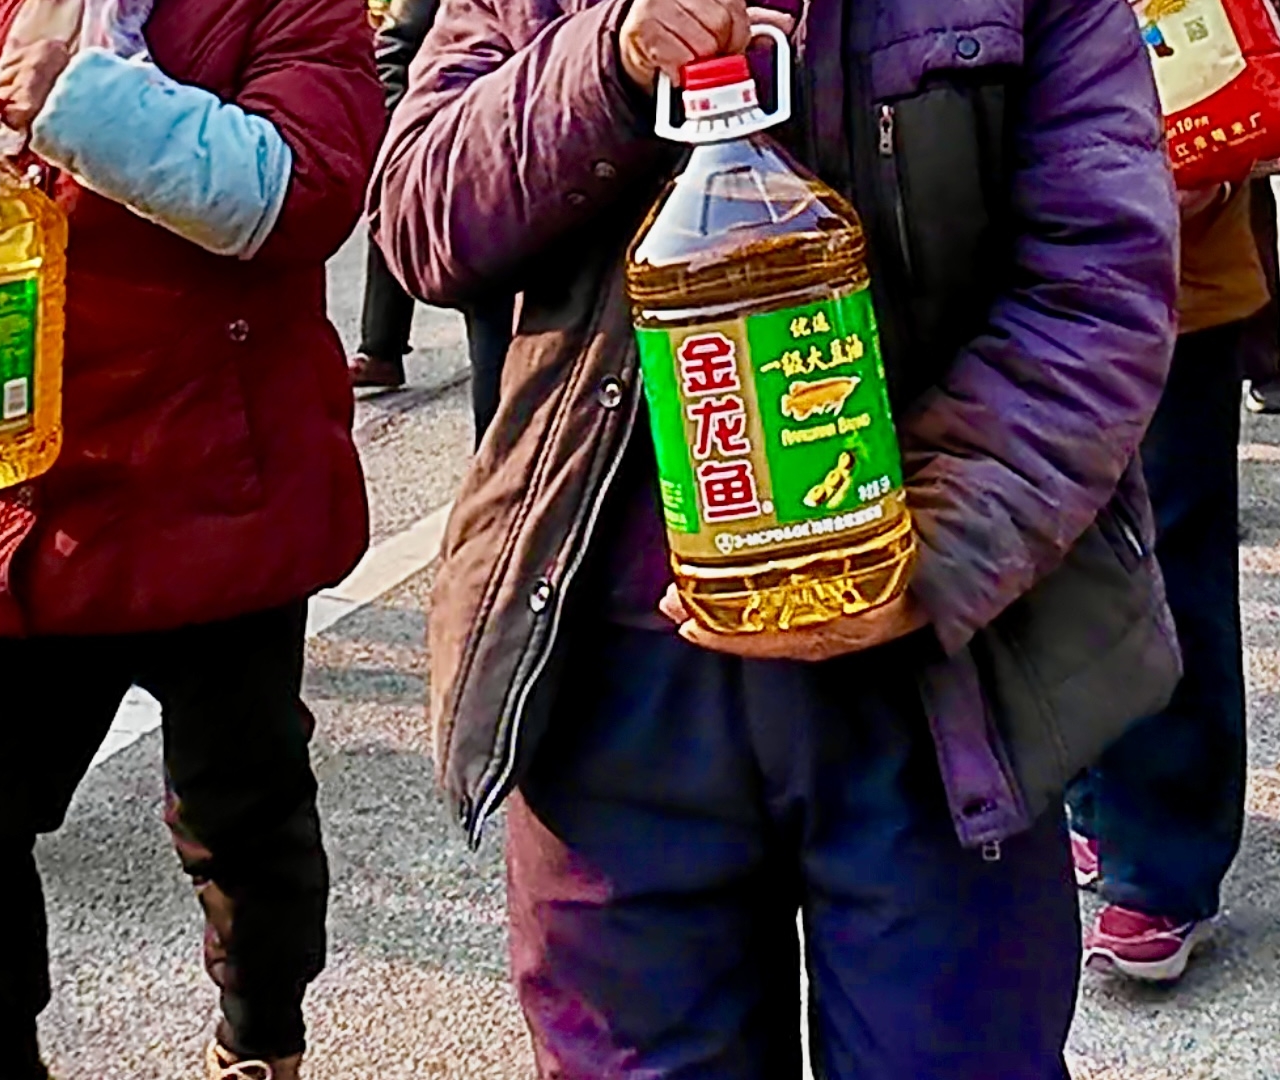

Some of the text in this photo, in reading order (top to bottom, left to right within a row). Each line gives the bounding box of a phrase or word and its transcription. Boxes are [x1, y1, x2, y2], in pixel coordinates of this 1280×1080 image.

[760, 333, 863, 378] 一级大豆油
[677, 333, 762, 522] 金龙鱼
